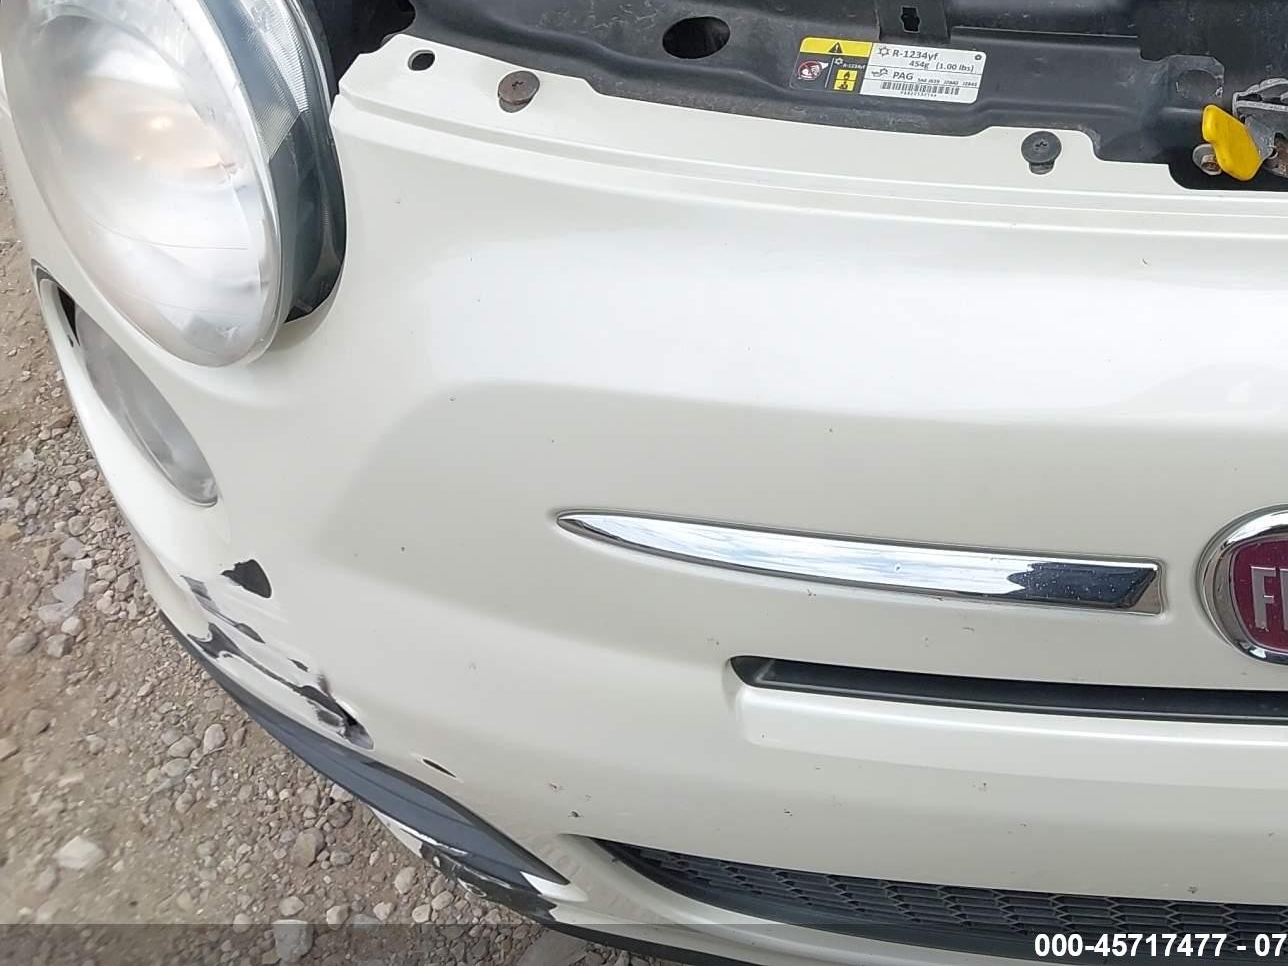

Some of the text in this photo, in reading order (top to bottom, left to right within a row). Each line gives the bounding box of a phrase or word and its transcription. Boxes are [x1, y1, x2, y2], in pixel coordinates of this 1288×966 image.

[891, 48, 938, 62] R-1234yf
[908, 61, 975, 72] 454g (1.00 lbs)
[892, 71, 914, 81] PAG
